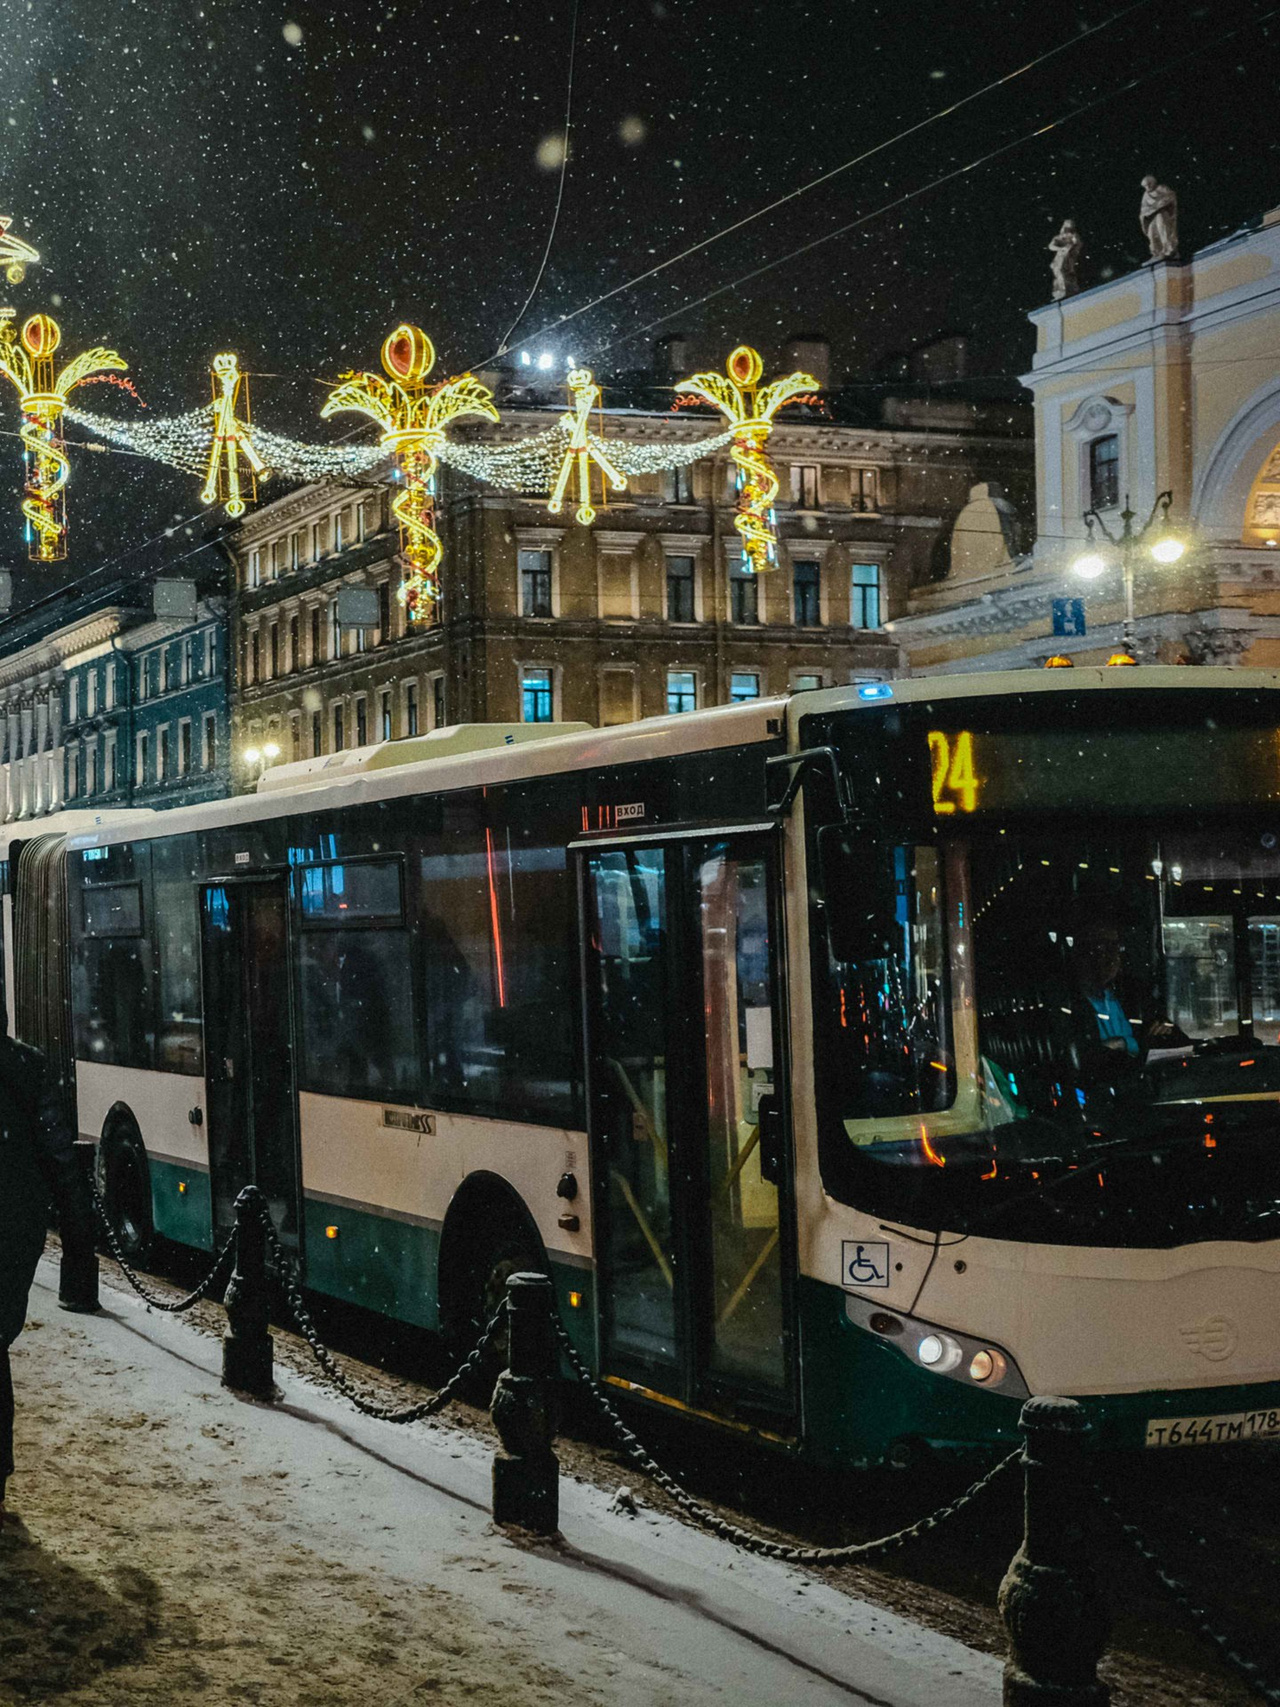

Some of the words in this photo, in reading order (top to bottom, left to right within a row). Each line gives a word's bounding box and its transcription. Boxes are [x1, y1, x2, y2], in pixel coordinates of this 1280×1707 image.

[927, 731, 978, 811] 24
[617, 805, 643, 817] ВХОД
[1247, 1411, 1277, 1430] 178
